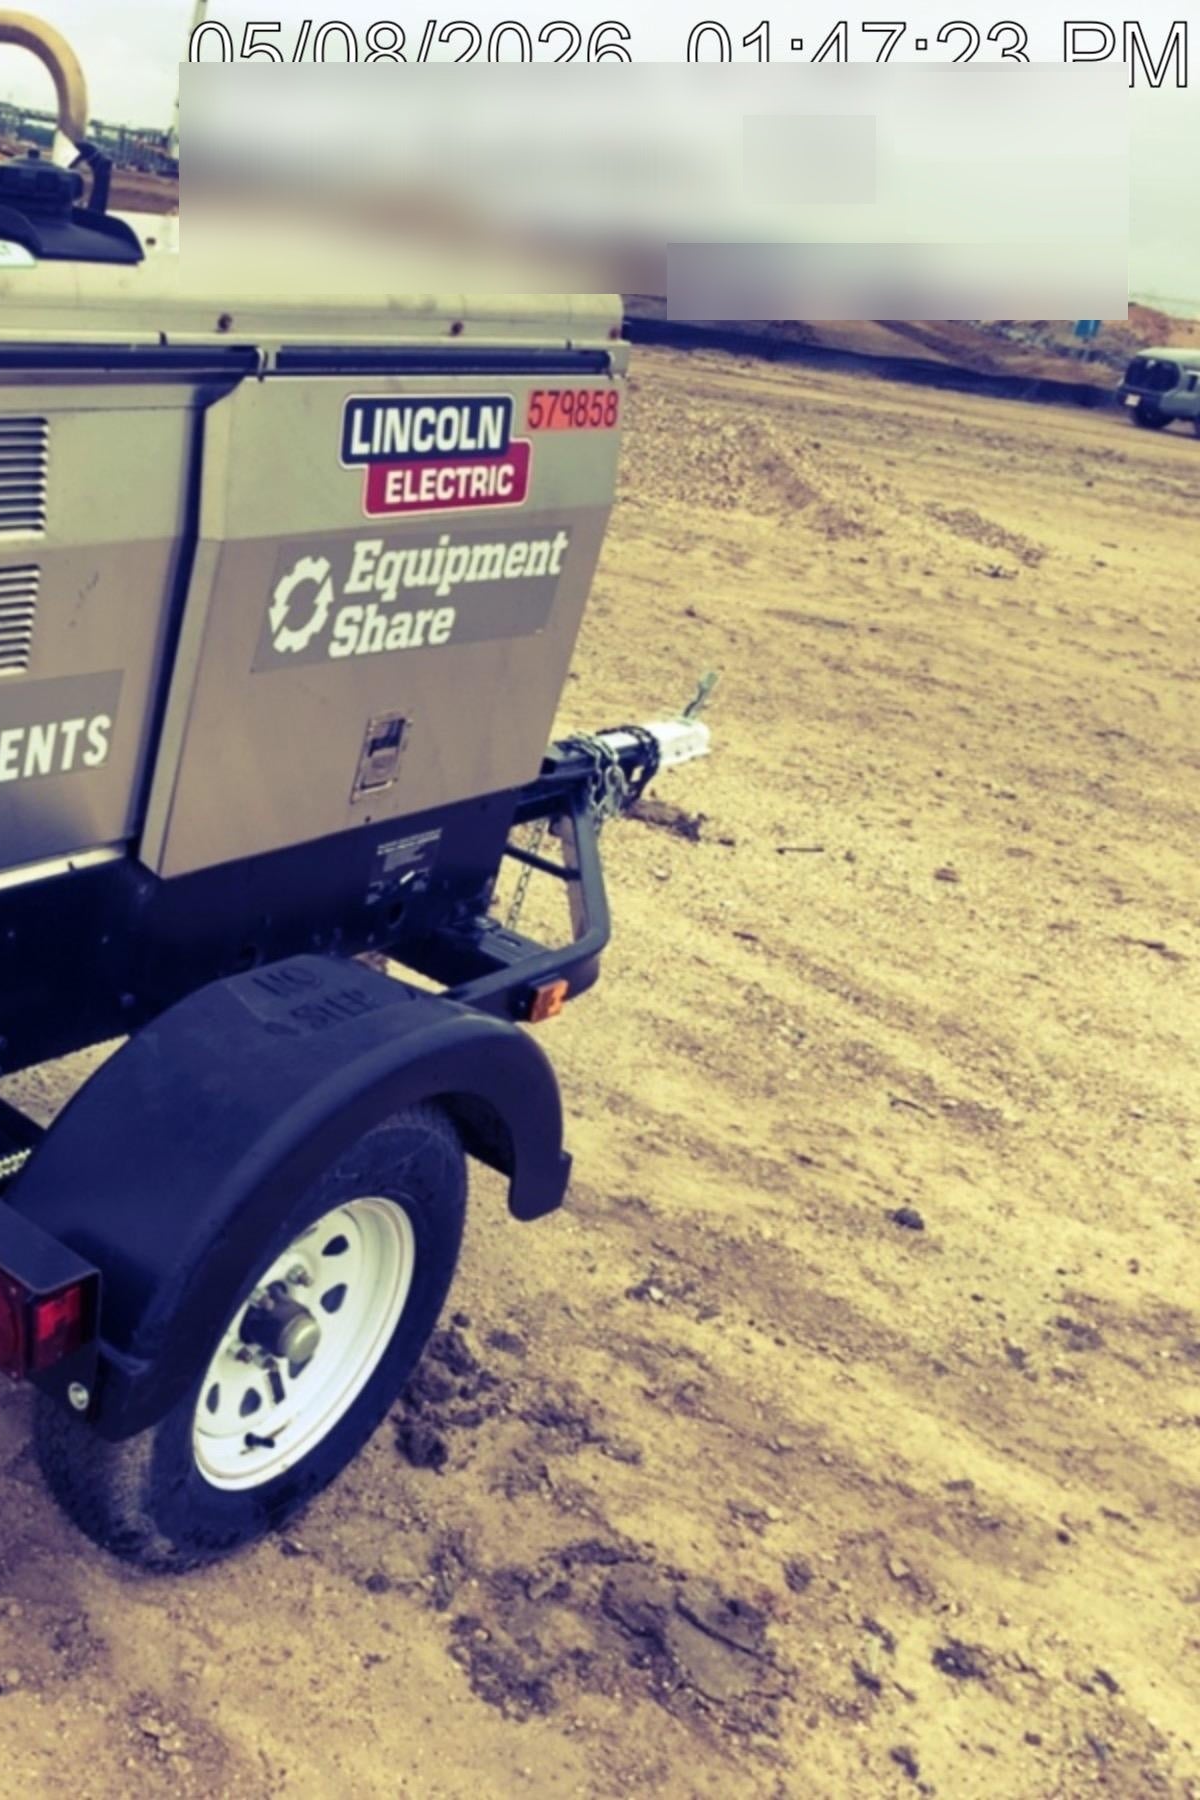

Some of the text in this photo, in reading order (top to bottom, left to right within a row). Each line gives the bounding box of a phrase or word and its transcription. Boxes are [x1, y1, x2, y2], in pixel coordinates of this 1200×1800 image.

[351, 406, 504, 455] LINCOLN
[528, 388, 620, 429] 579858
[385, 464, 515, 504] ELECTRIC
[343, 531, 568, 602] Equipment
[328, 604, 456, 658] Share
